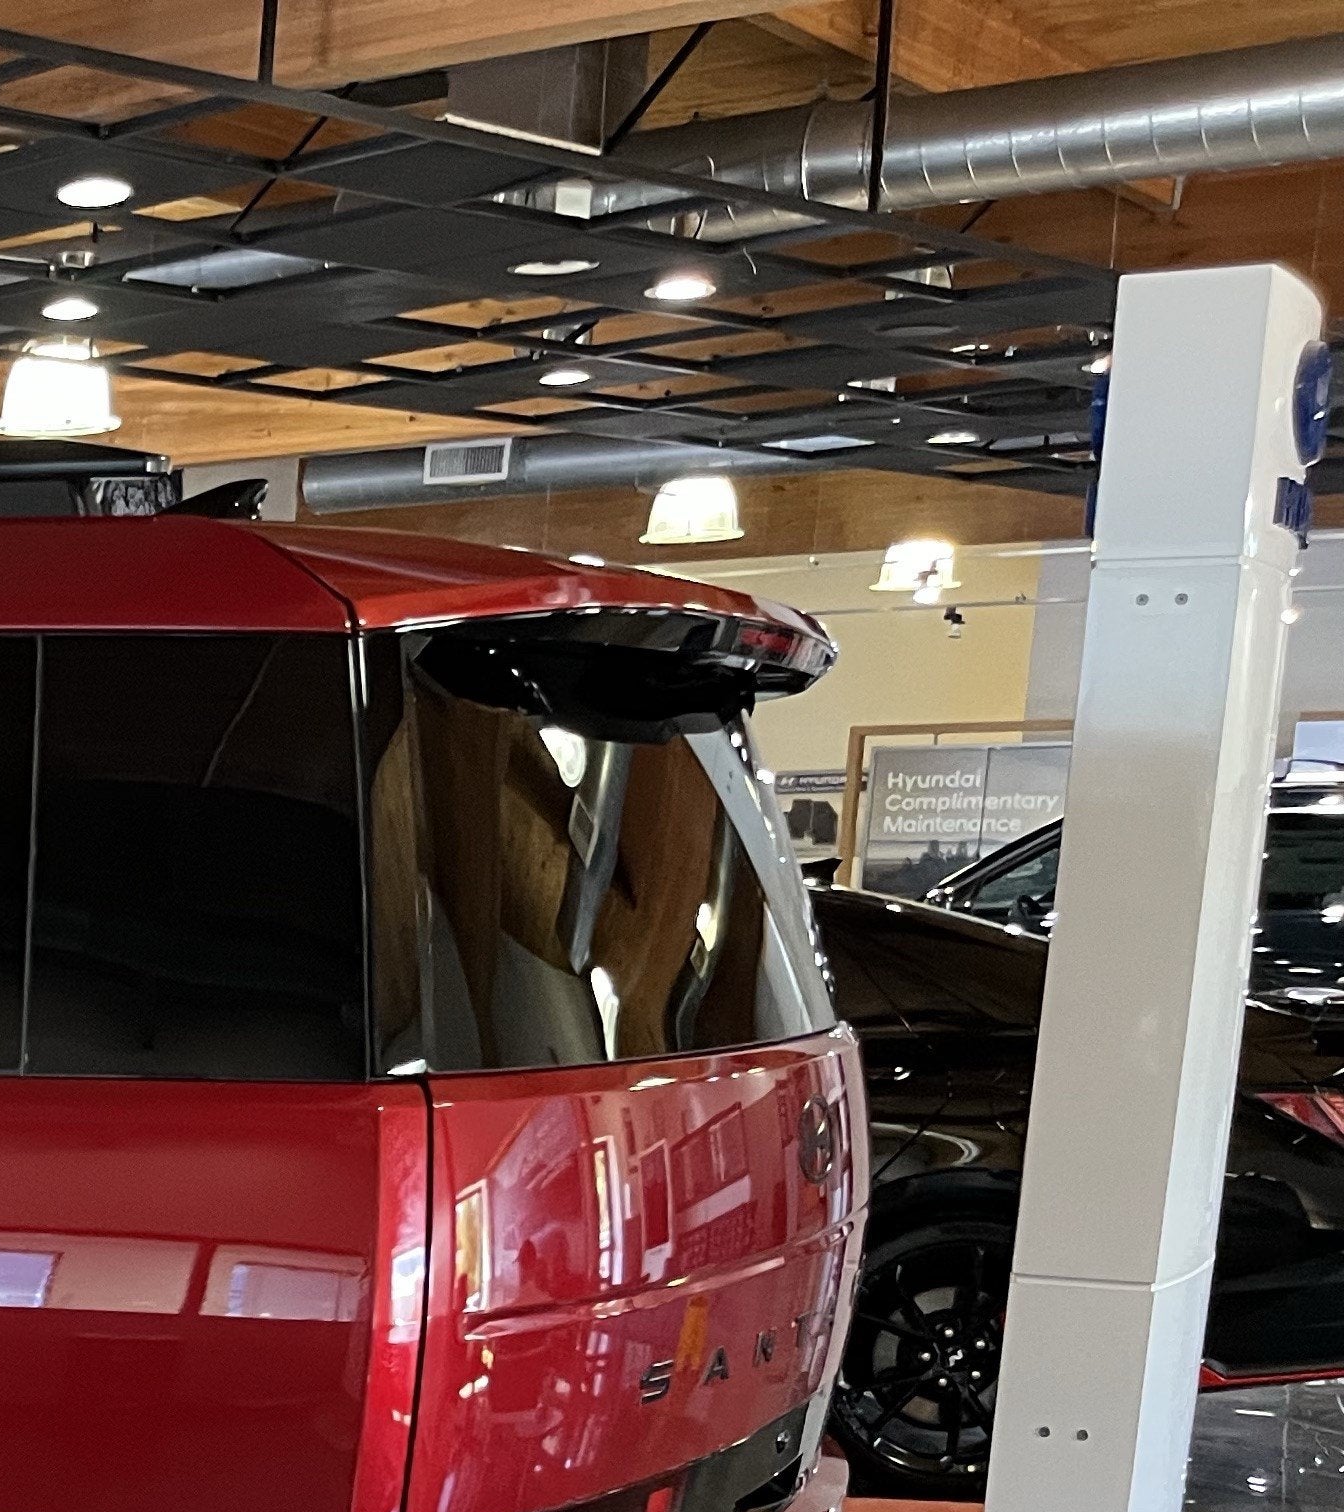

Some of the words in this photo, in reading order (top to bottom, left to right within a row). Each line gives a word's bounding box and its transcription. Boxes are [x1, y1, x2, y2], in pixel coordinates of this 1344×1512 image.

[799, 776, 847, 786] HYUNDA
[886, 769, 982, 793] Hyundai
[885, 793, 1059, 813] Complimentary
[882, 814, 1022, 834] Maintenance
[639, 1312, 817, 1405] SANT
